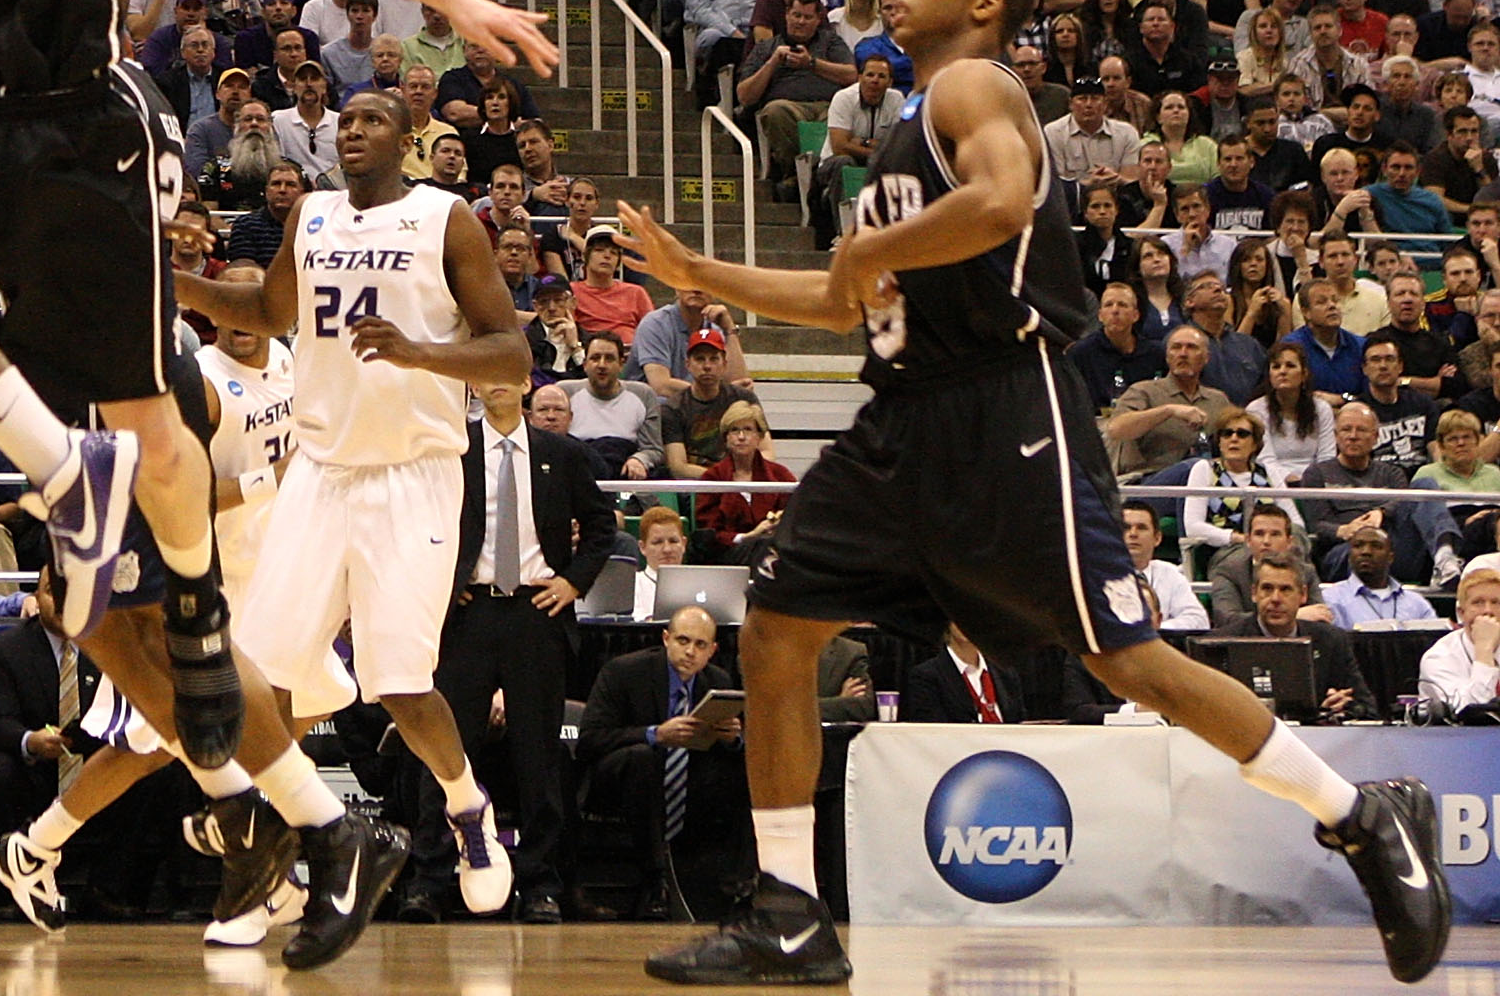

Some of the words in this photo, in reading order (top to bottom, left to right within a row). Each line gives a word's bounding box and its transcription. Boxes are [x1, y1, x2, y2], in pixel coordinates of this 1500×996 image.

[303, 248, 415, 272] K-STATE
[314, 285, 383, 338] 24
[938, 825, 1073, 866] NCAA
